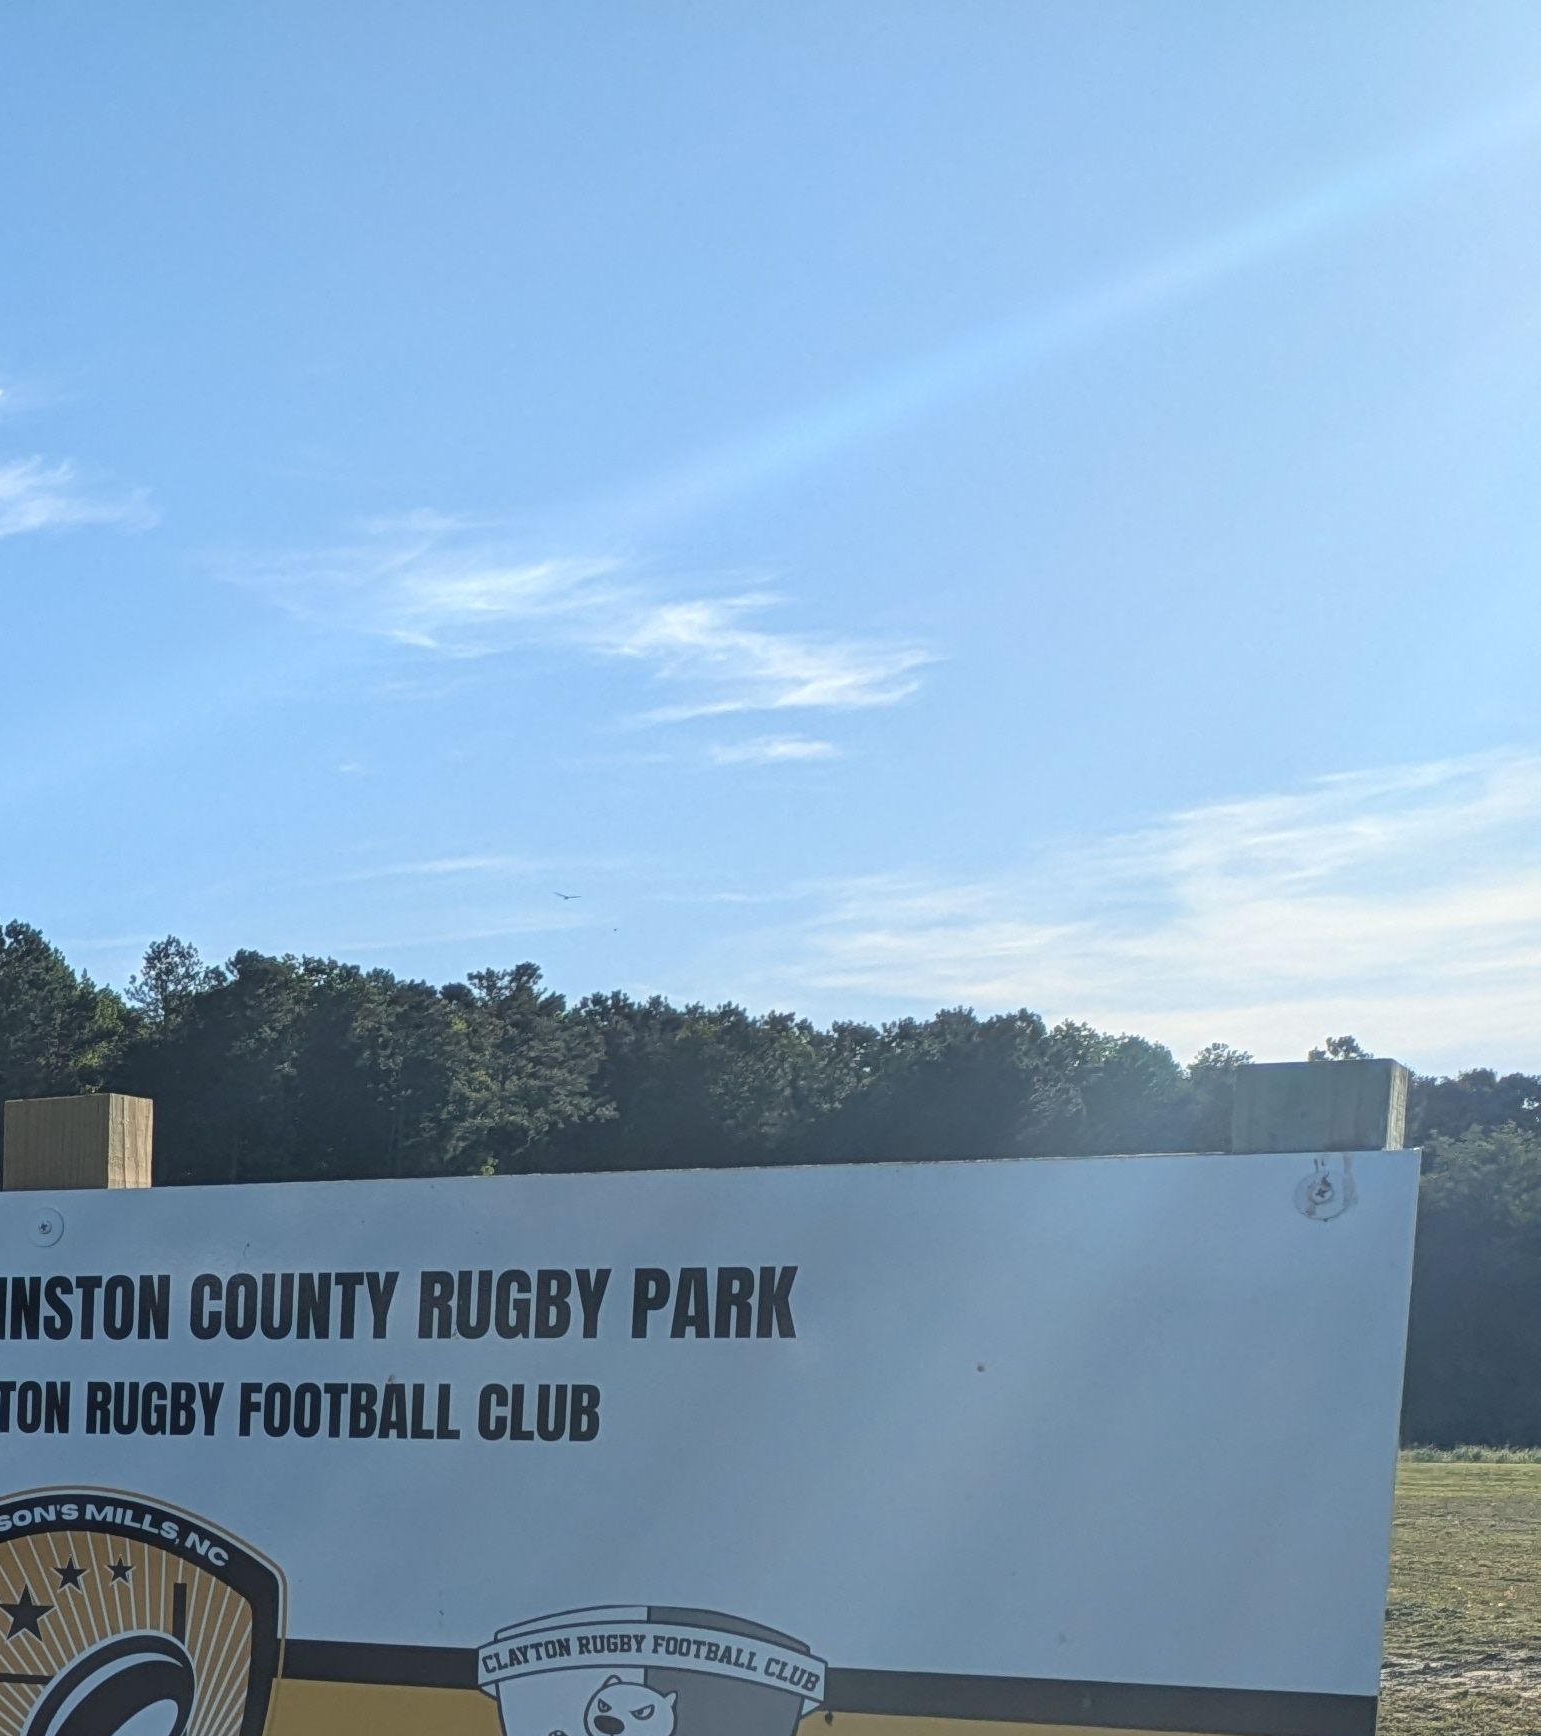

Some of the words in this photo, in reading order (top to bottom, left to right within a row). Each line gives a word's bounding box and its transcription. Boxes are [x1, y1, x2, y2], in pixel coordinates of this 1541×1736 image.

[189, 1271, 399, 1340] COUNTY
[416, 1268, 612, 1340] RUGBY
[630, 1265, 799, 1340] PARK
[85, 1381, 225, 1437] RUGBY
[238, 1381, 460, 1440] FOOTBALL
[477, 1382, 601, 1442] CLUB
[183, 1532, 231, 1567] NC
[481, 1639, 572, 1674] CLAYTON
[576, 1634, 647, 1655] RUGBY
[652, 1635, 758, 1672] FOOTBALL
[763, 1658, 821, 1693] CLUB
